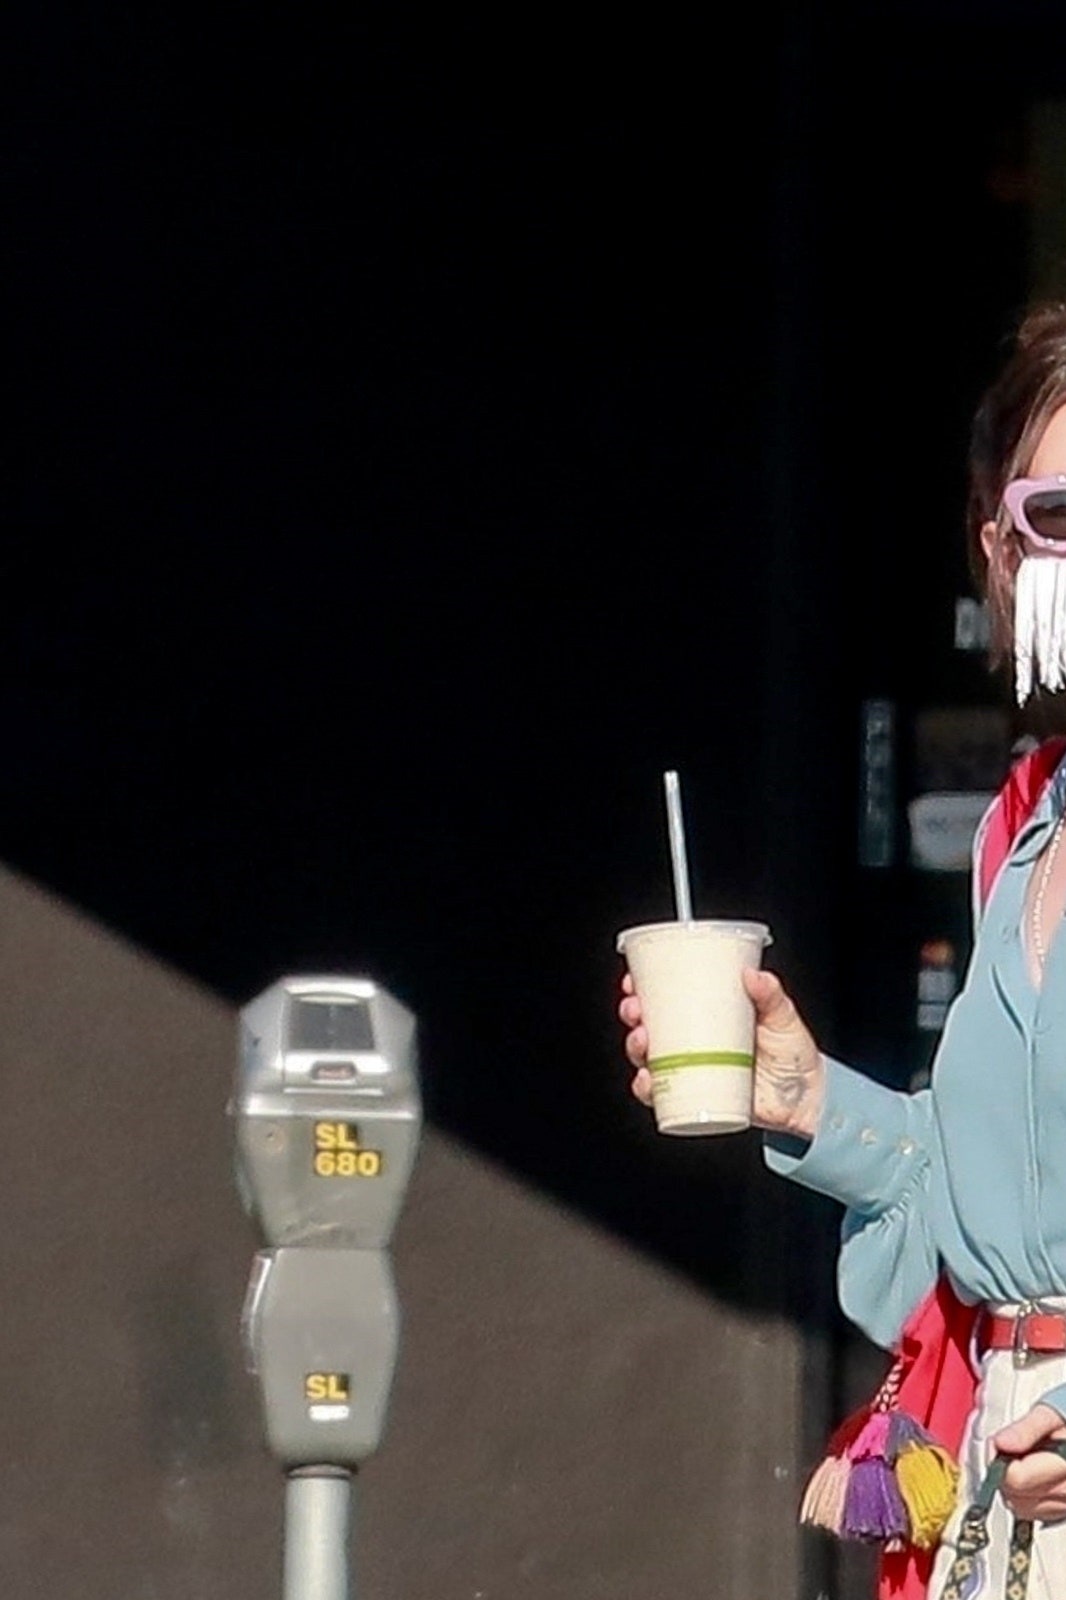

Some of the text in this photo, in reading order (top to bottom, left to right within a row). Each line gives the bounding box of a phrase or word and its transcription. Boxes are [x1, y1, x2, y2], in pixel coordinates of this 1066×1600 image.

[315, 1122, 357, 1149] SL
[315, 1151, 380, 1177] 680
[305, 1374, 348, 1400] SL
